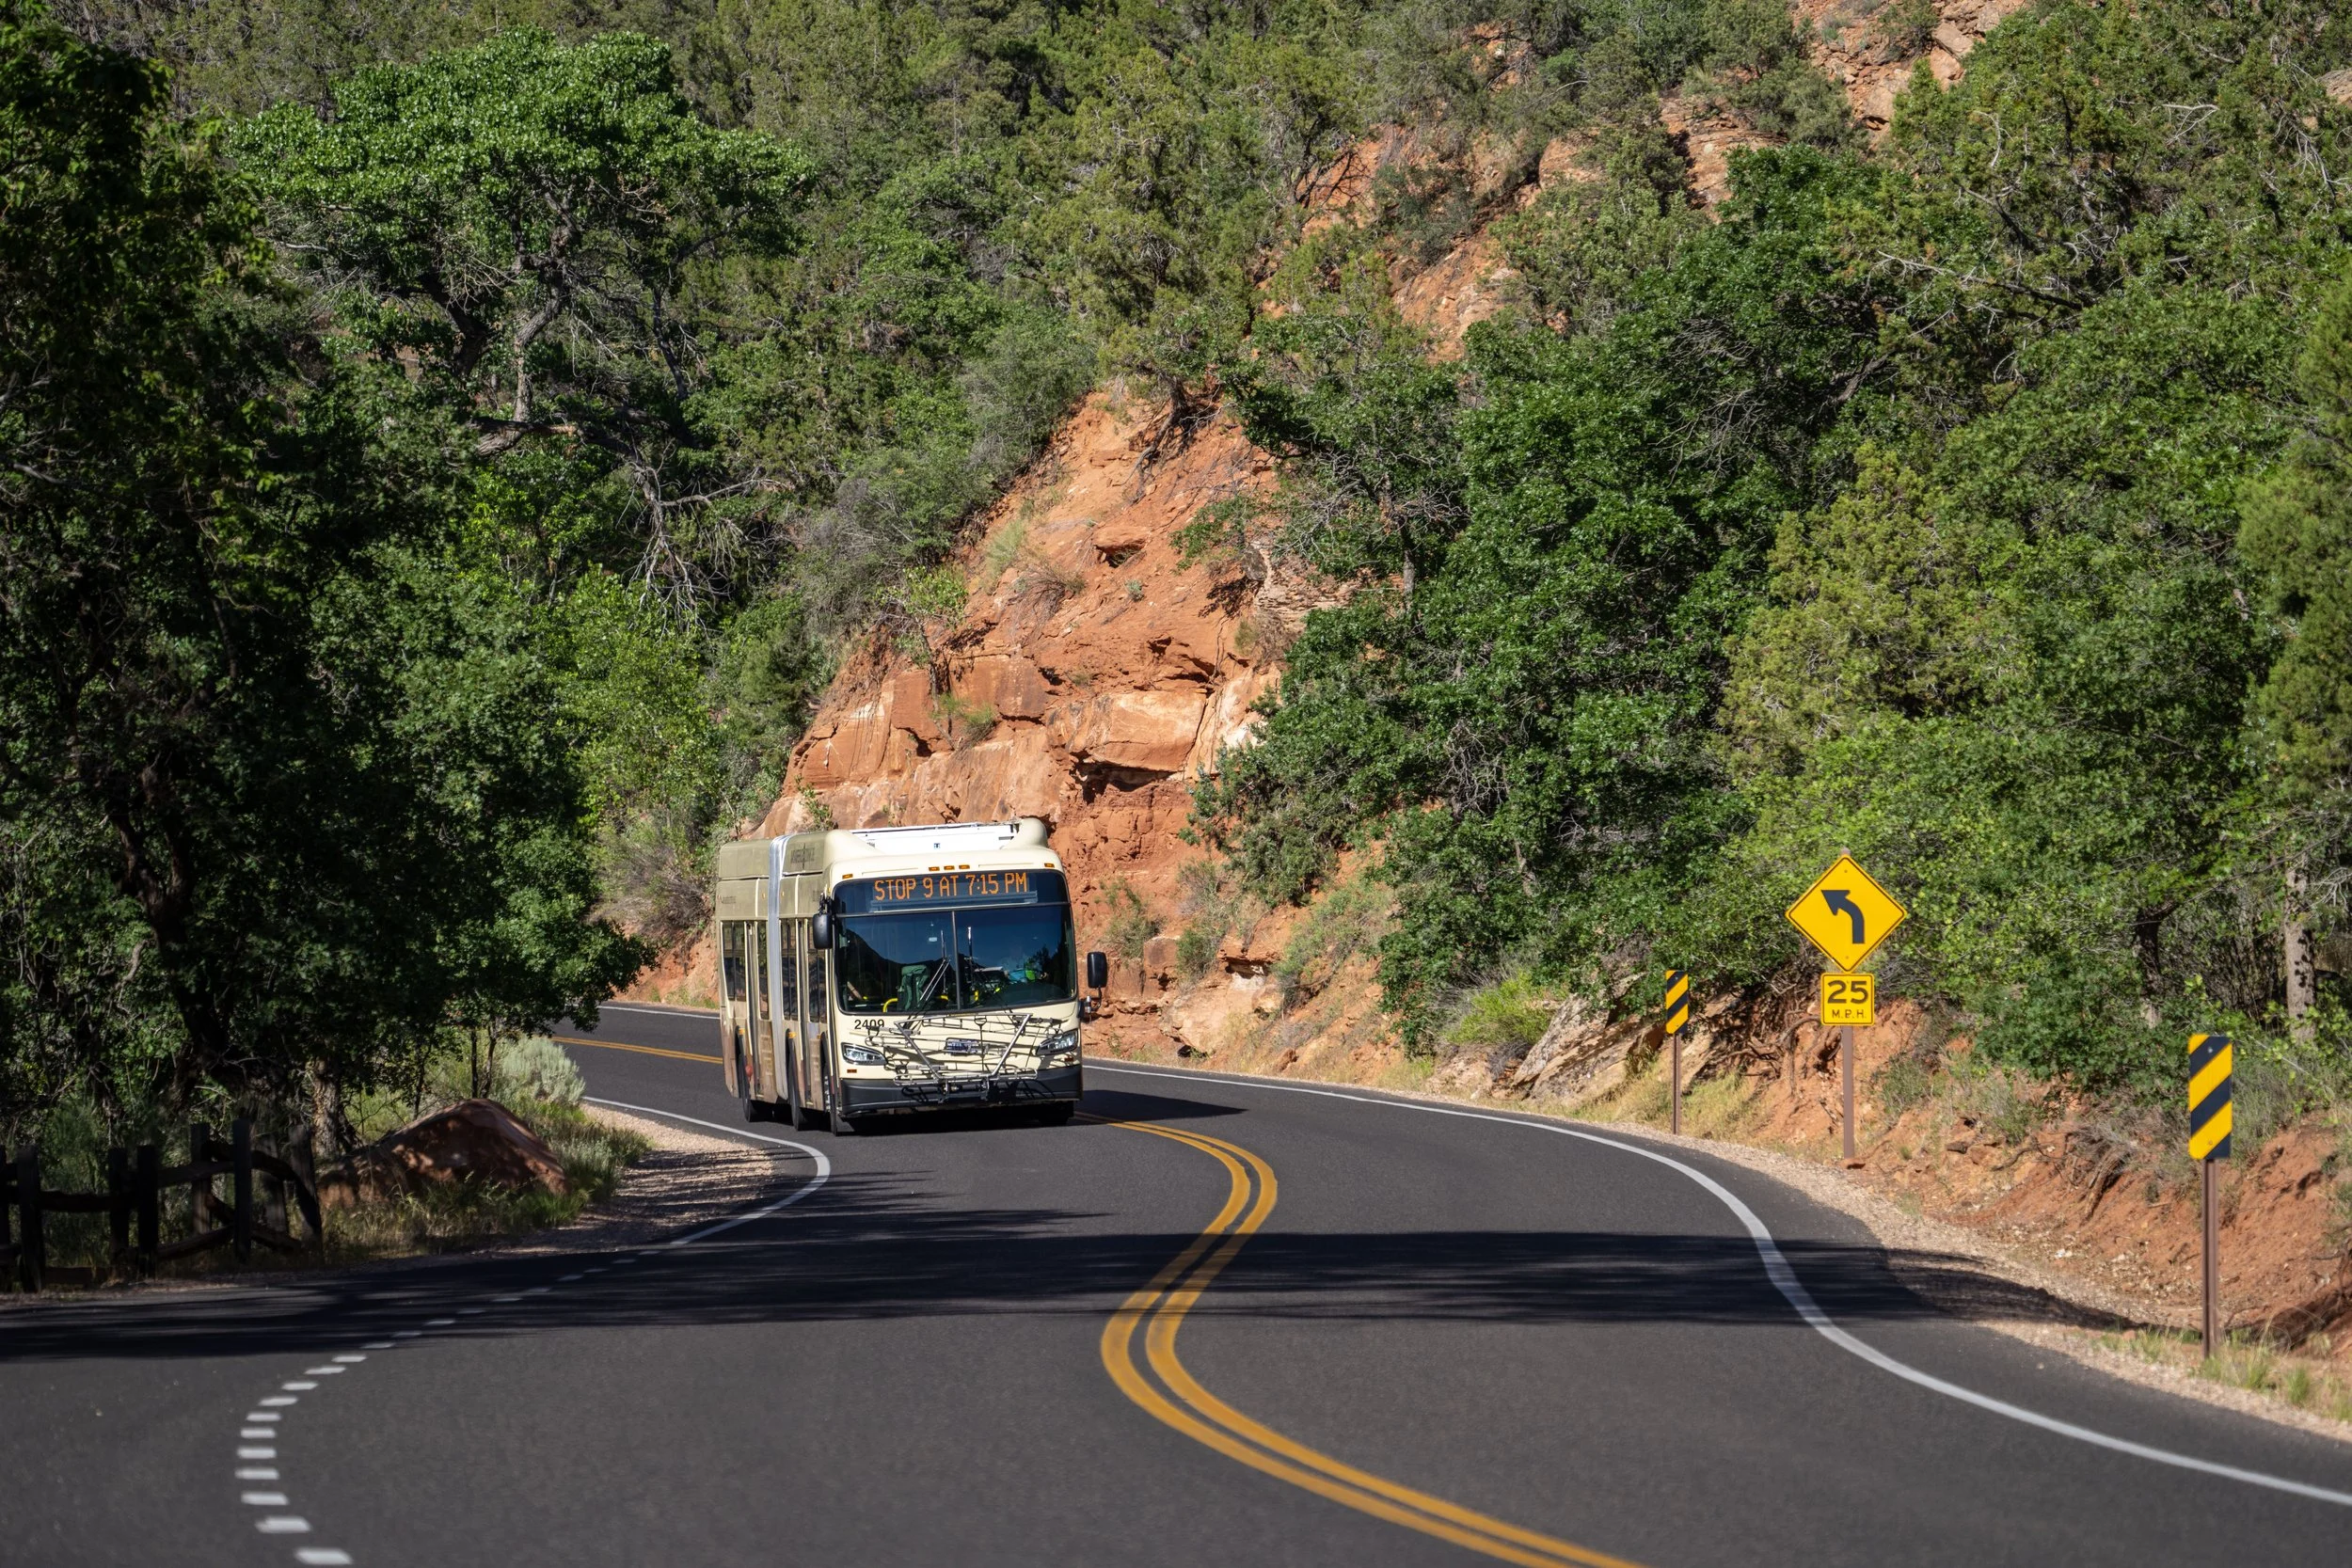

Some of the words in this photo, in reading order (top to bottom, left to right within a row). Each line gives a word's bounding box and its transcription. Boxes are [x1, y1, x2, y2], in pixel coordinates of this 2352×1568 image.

[874, 878, 916, 901] STOP
[923, 877, 933, 898] 9
[939, 875, 959, 896] AT
[965, 873, 999, 895] 7:15
[1005, 872, 1027, 894] PM
[1827, 980, 1868, 1005] 25
[854, 1019, 884, 1030] 2409
